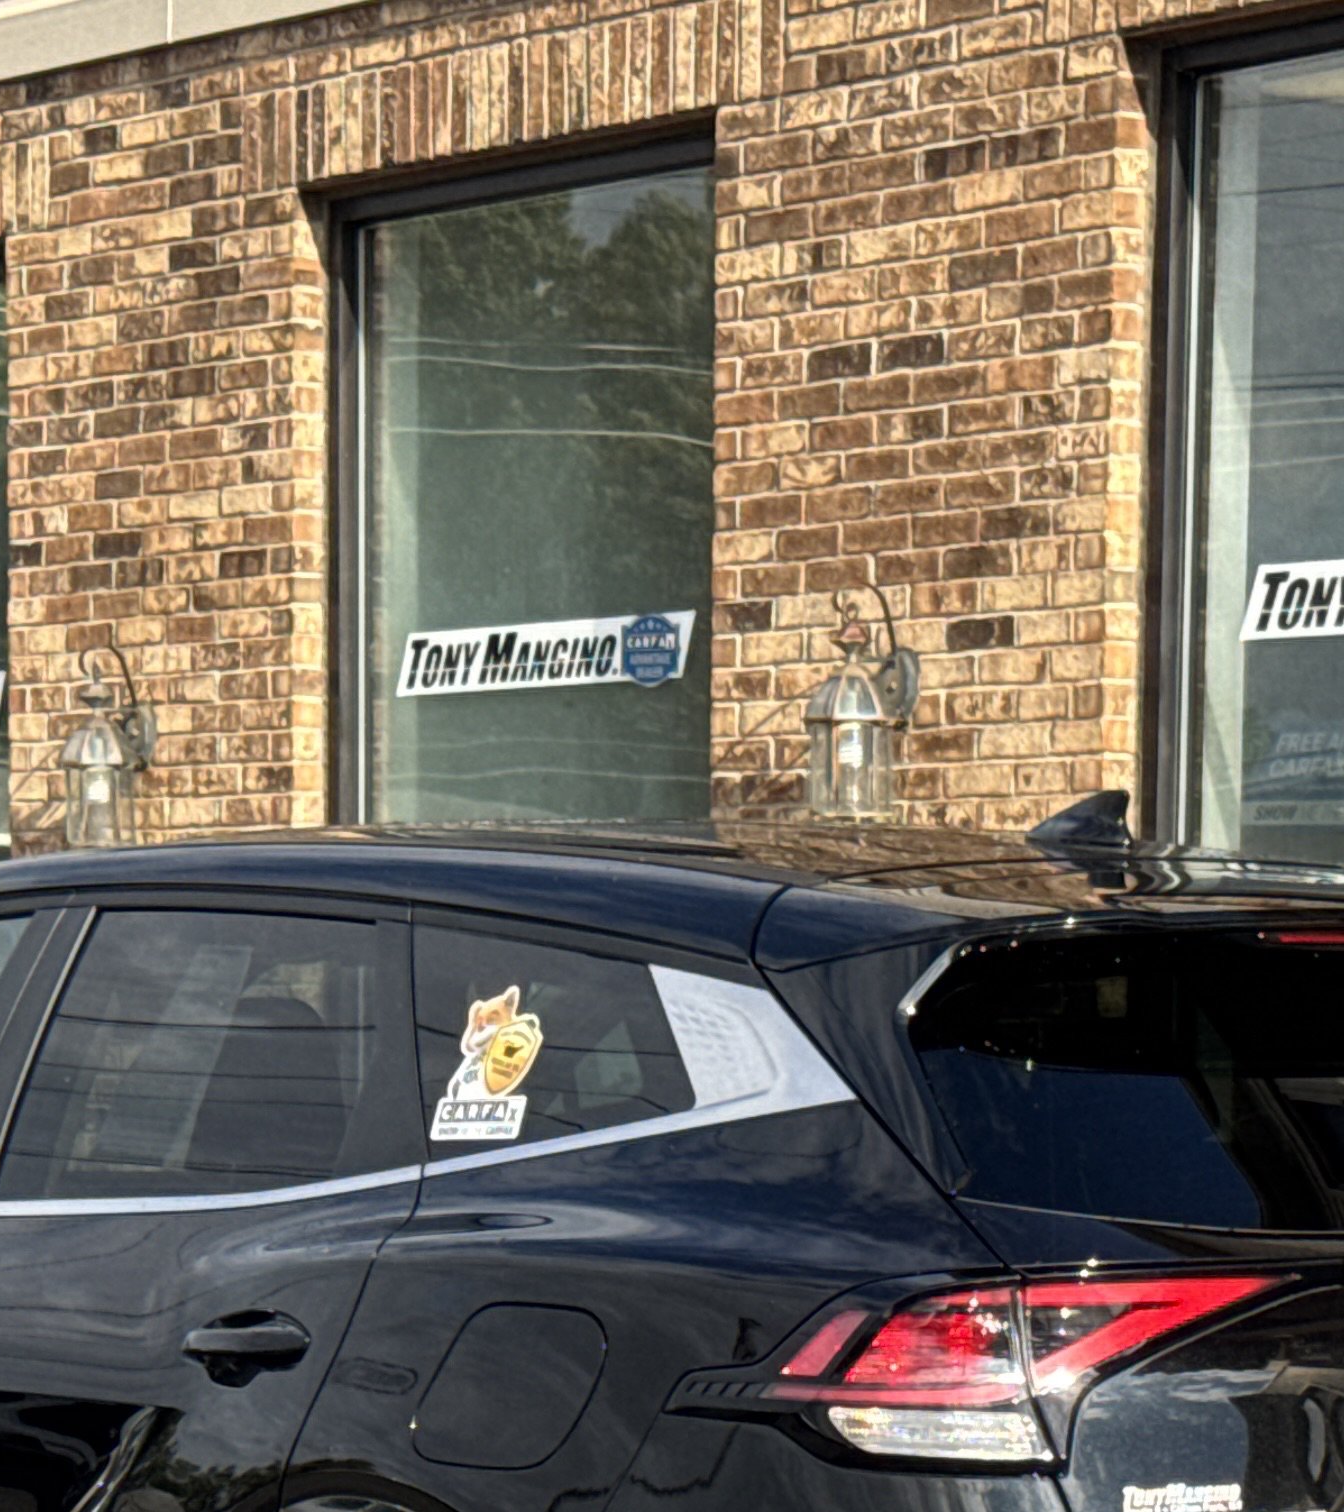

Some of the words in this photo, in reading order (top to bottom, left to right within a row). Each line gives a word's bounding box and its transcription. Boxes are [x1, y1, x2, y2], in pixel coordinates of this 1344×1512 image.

[406, 638, 481, 690] TONY
[479, 632, 617, 684] MANGINO
[441, 1103, 518, 1121] CARFAX
